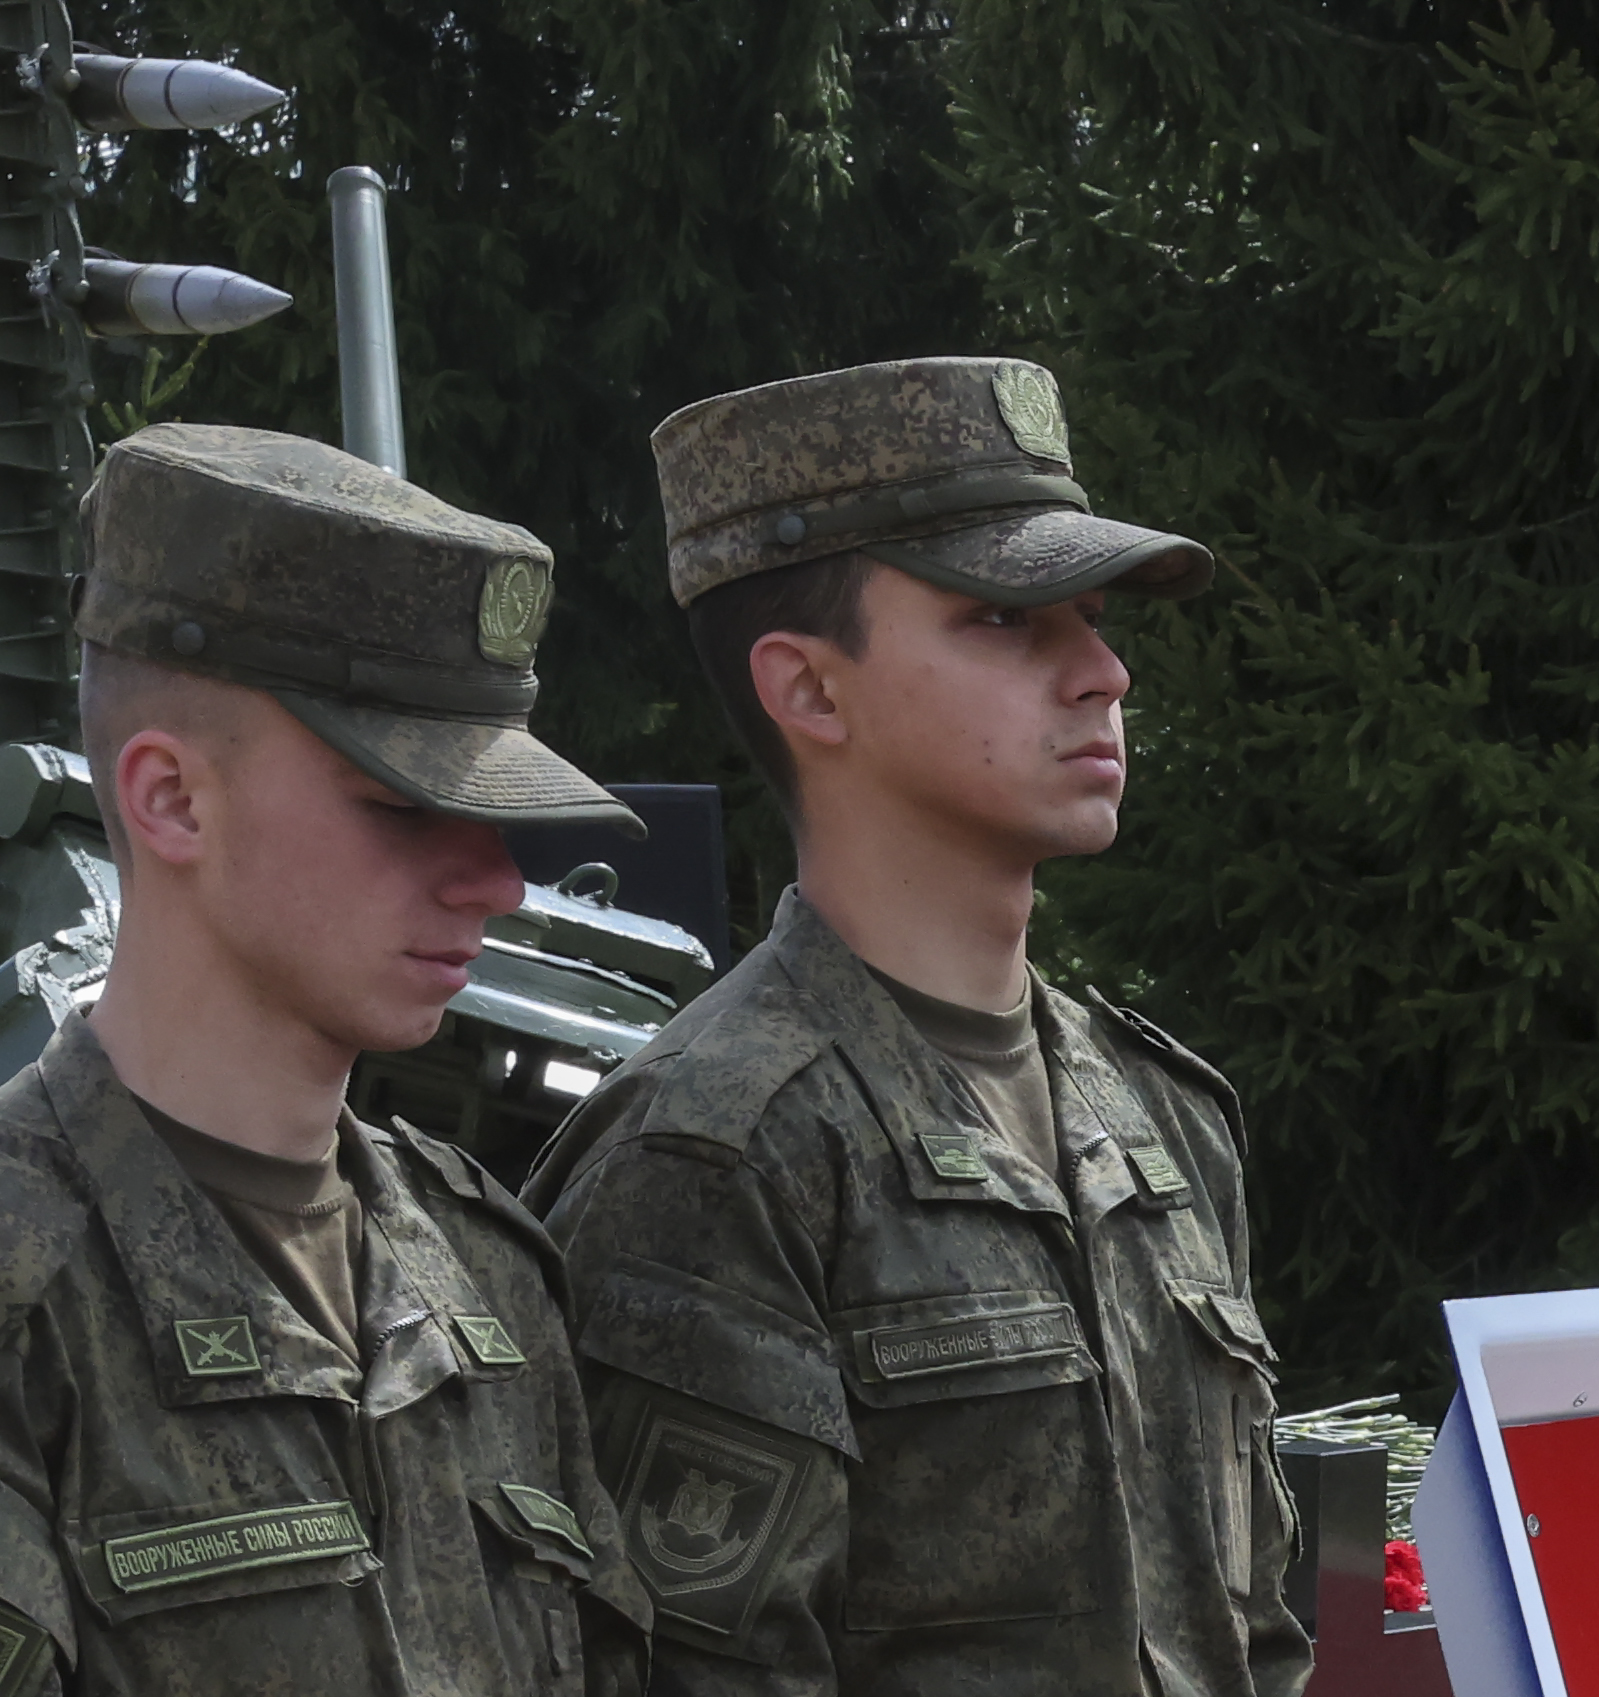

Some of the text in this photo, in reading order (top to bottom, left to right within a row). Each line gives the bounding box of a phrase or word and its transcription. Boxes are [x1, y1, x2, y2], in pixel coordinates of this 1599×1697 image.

[880, 1330, 989, 1365] ВООРУЖЕННЫЕ
[114, 1513, 356, 1578] ВООРУЖЕННЫЕ СИЛЫ РОССИИ
